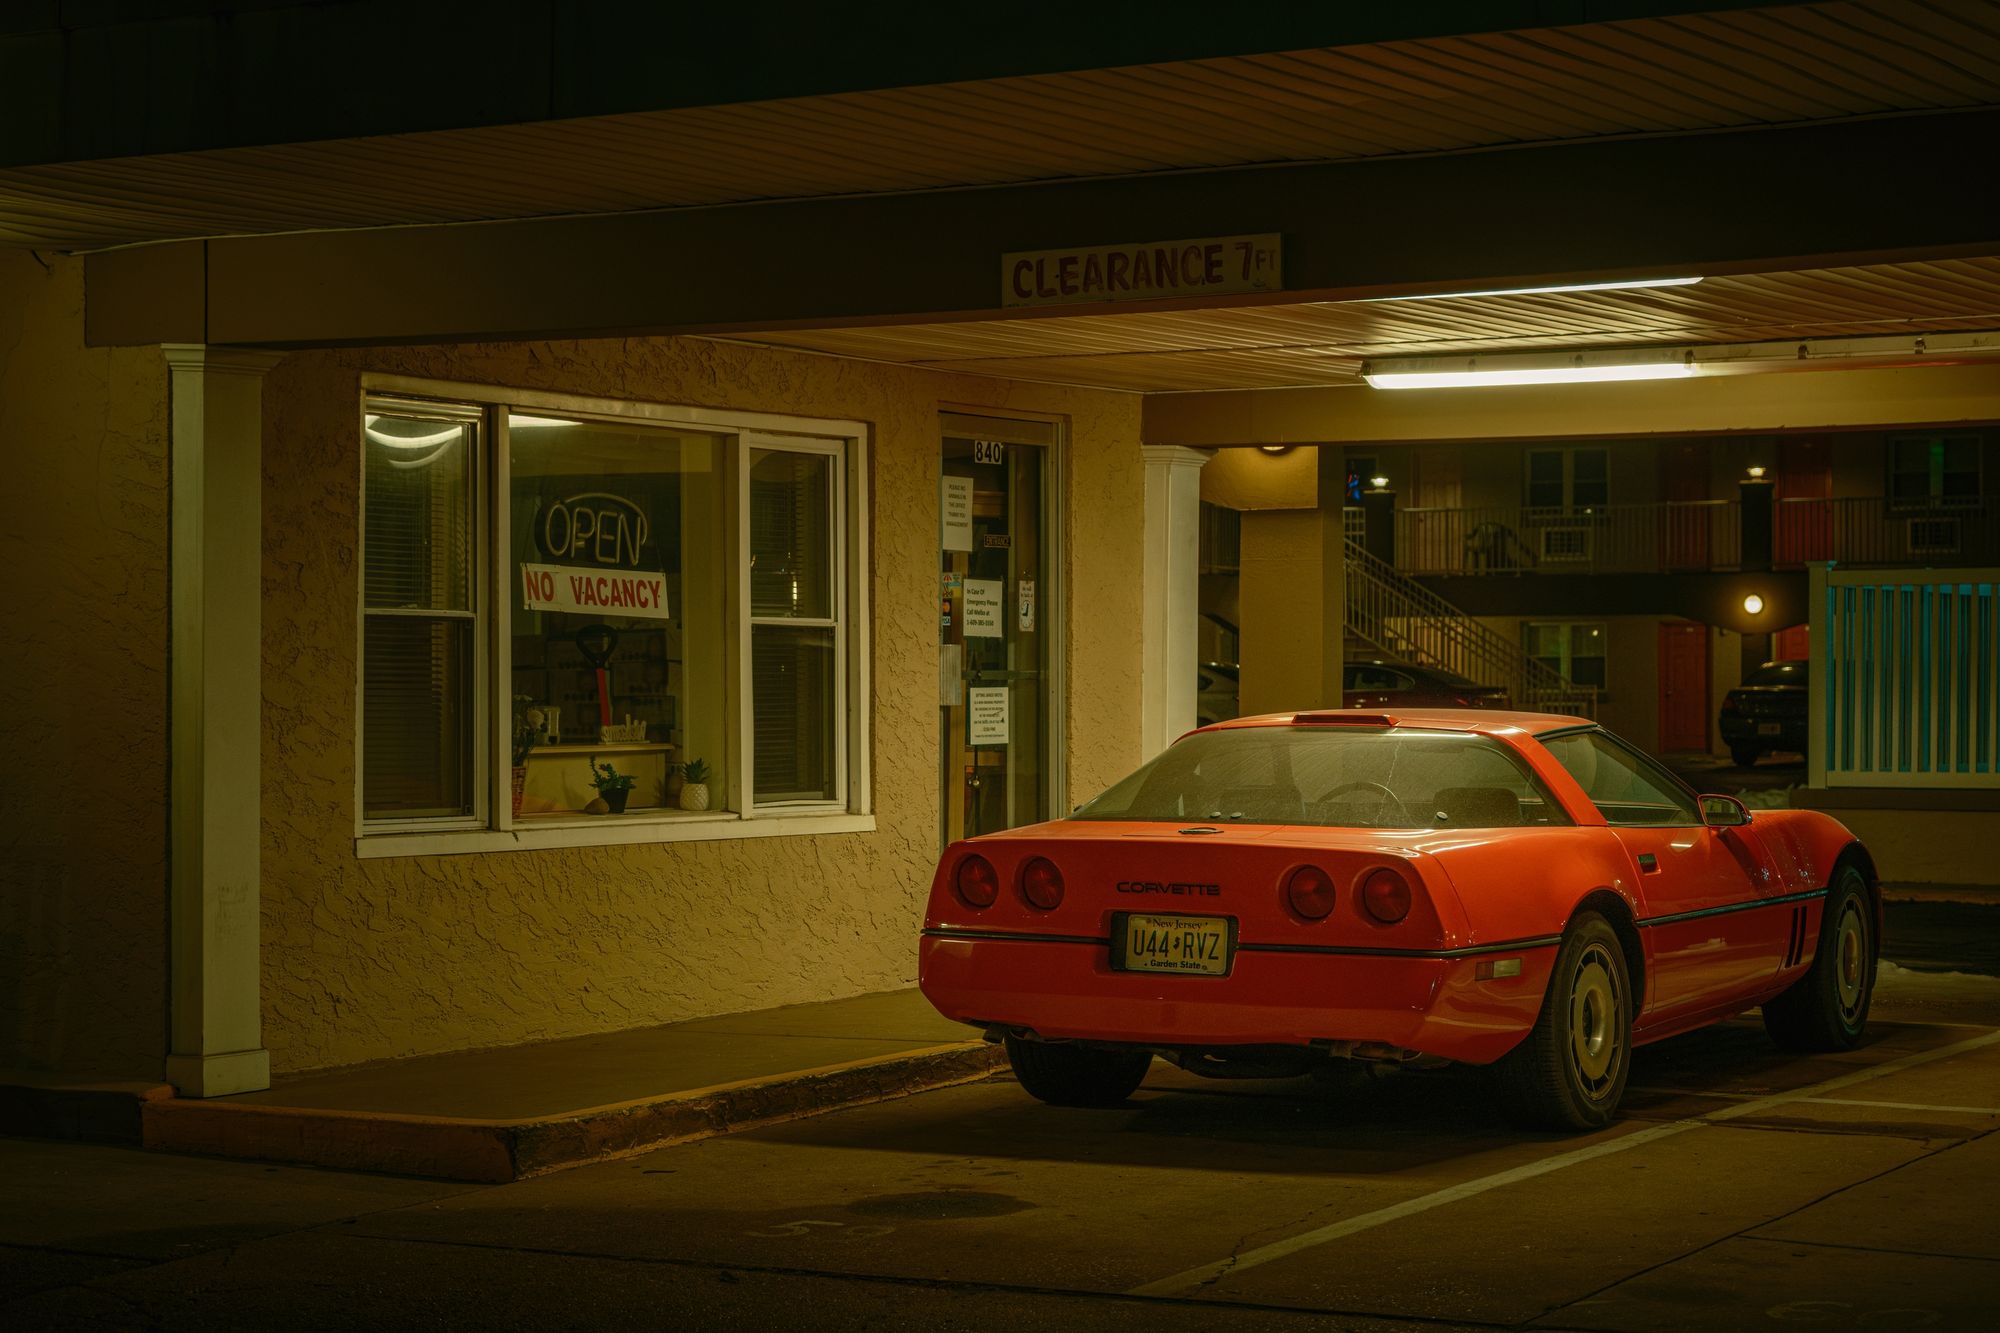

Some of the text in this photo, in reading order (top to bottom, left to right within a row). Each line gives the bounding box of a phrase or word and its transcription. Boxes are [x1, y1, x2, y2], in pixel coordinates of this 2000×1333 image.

[1013, 244, 1224, 299] CLEARANCE
[1235, 241, 1253, 281] 7
[976, 442, 1001, 463] 840
[545, 503, 642, 566] OPEN
[525, 570, 661, 609] NO VACANCY
[1116, 882, 1220, 896] CORVETTE
[1152, 918, 1202, 930] New Jersey
[1134, 929, 1220, 960] U44 RVZ
[1150, 959, 1201, 969] Garden State
